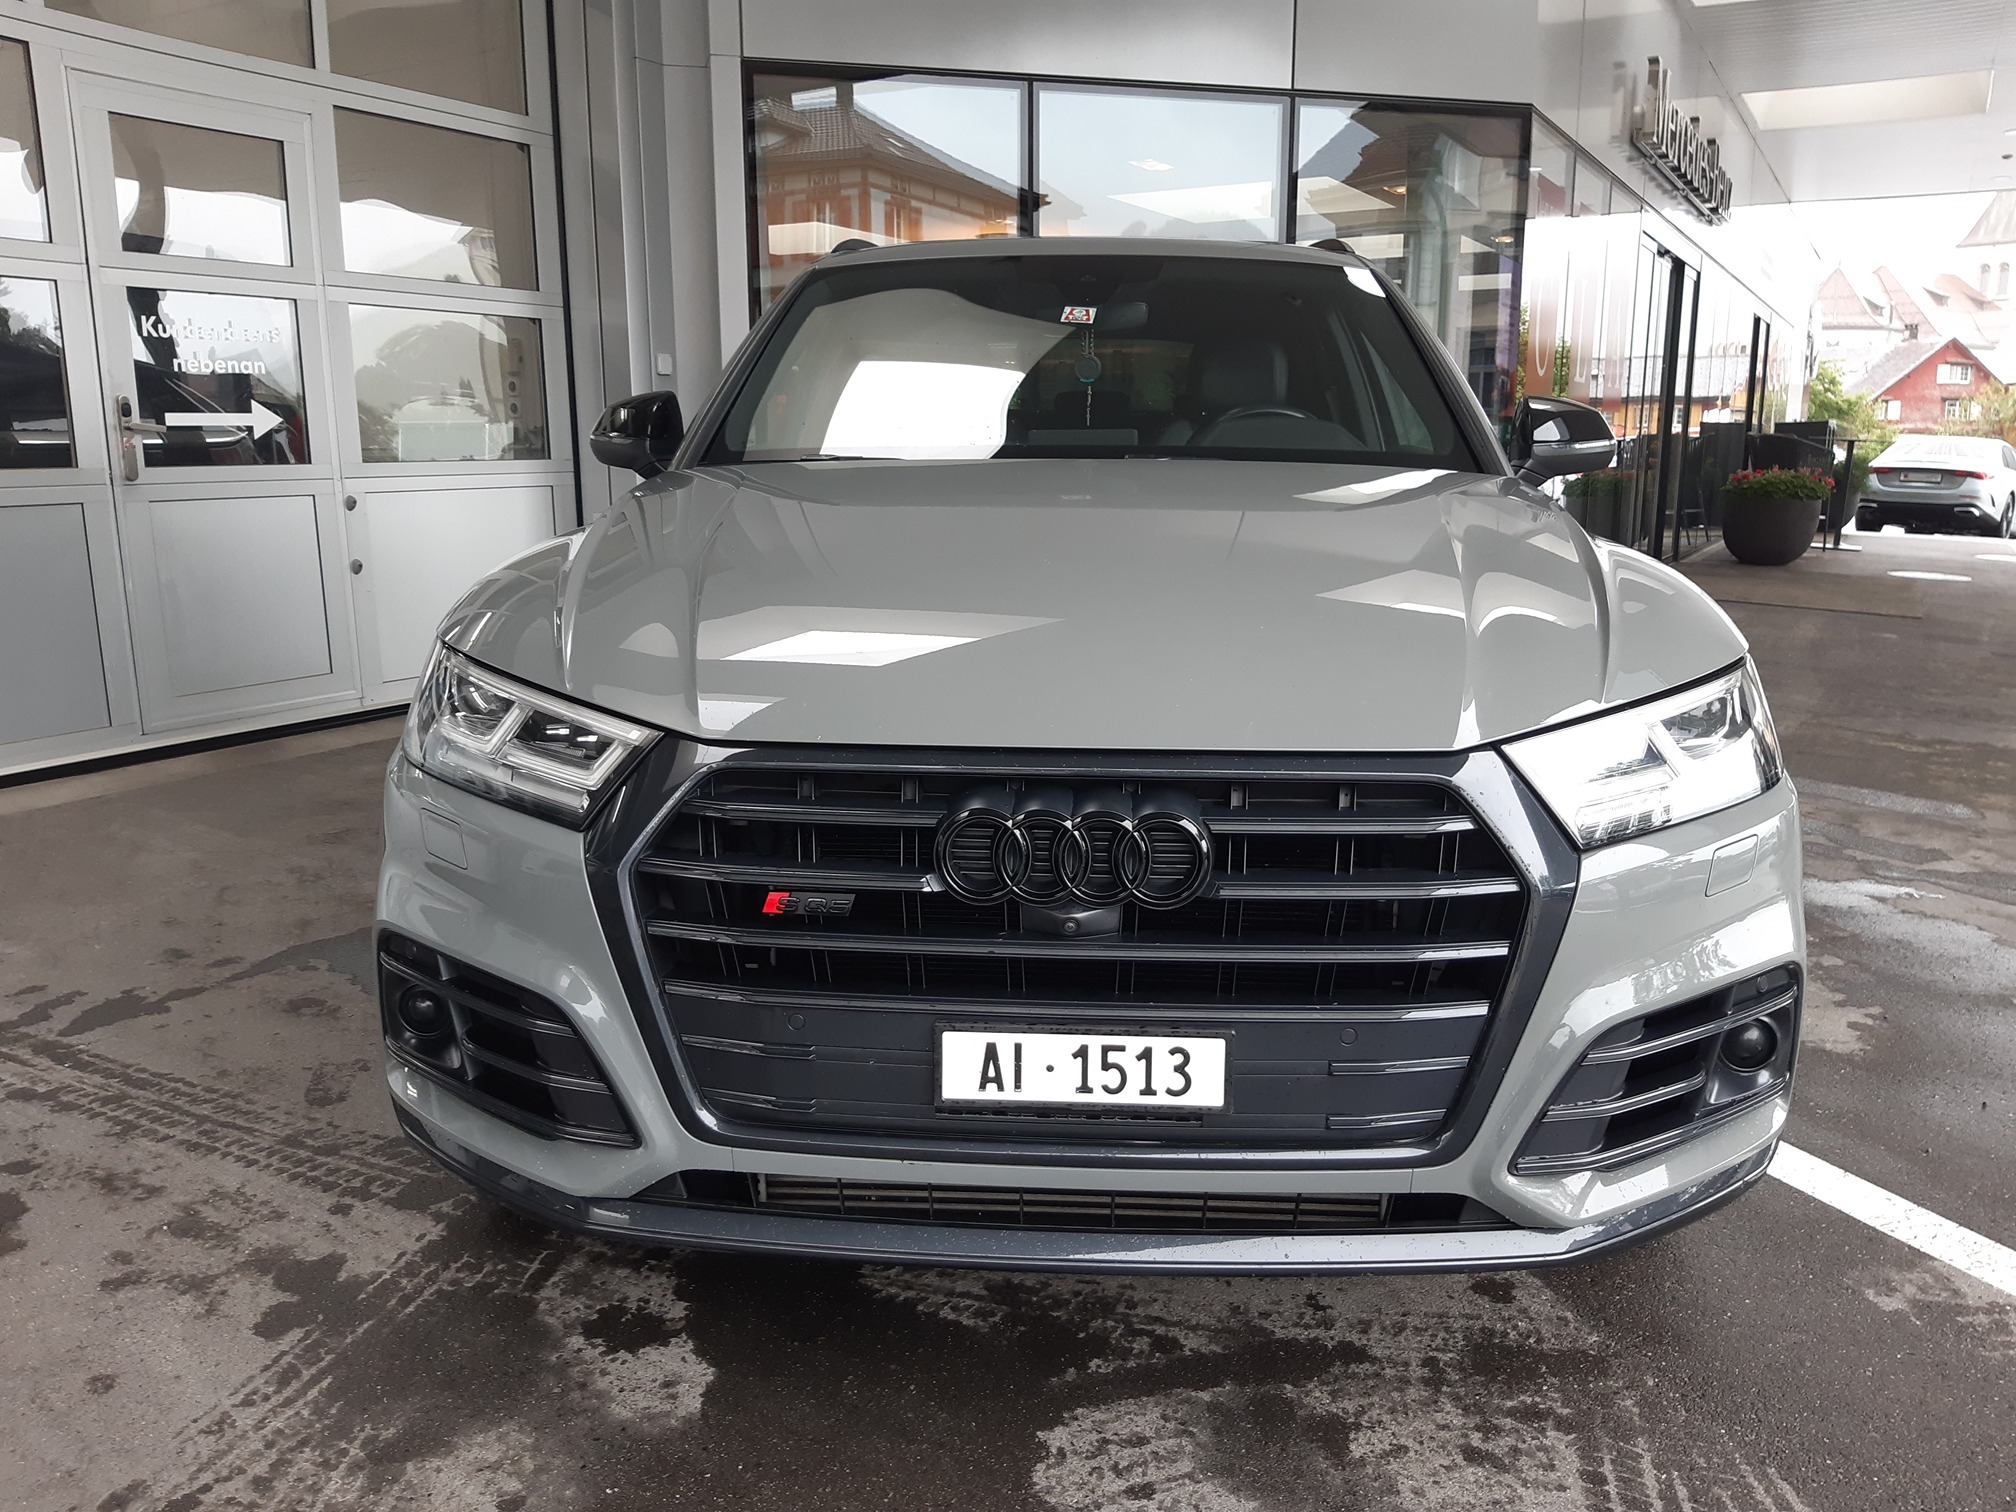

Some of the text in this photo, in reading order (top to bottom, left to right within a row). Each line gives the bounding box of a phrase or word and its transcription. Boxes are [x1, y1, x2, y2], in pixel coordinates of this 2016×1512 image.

[174, 351, 266, 375] nebenan
[775, 896, 851, 914] SQ5
[1071, 1043, 1192, 1097] 1513
